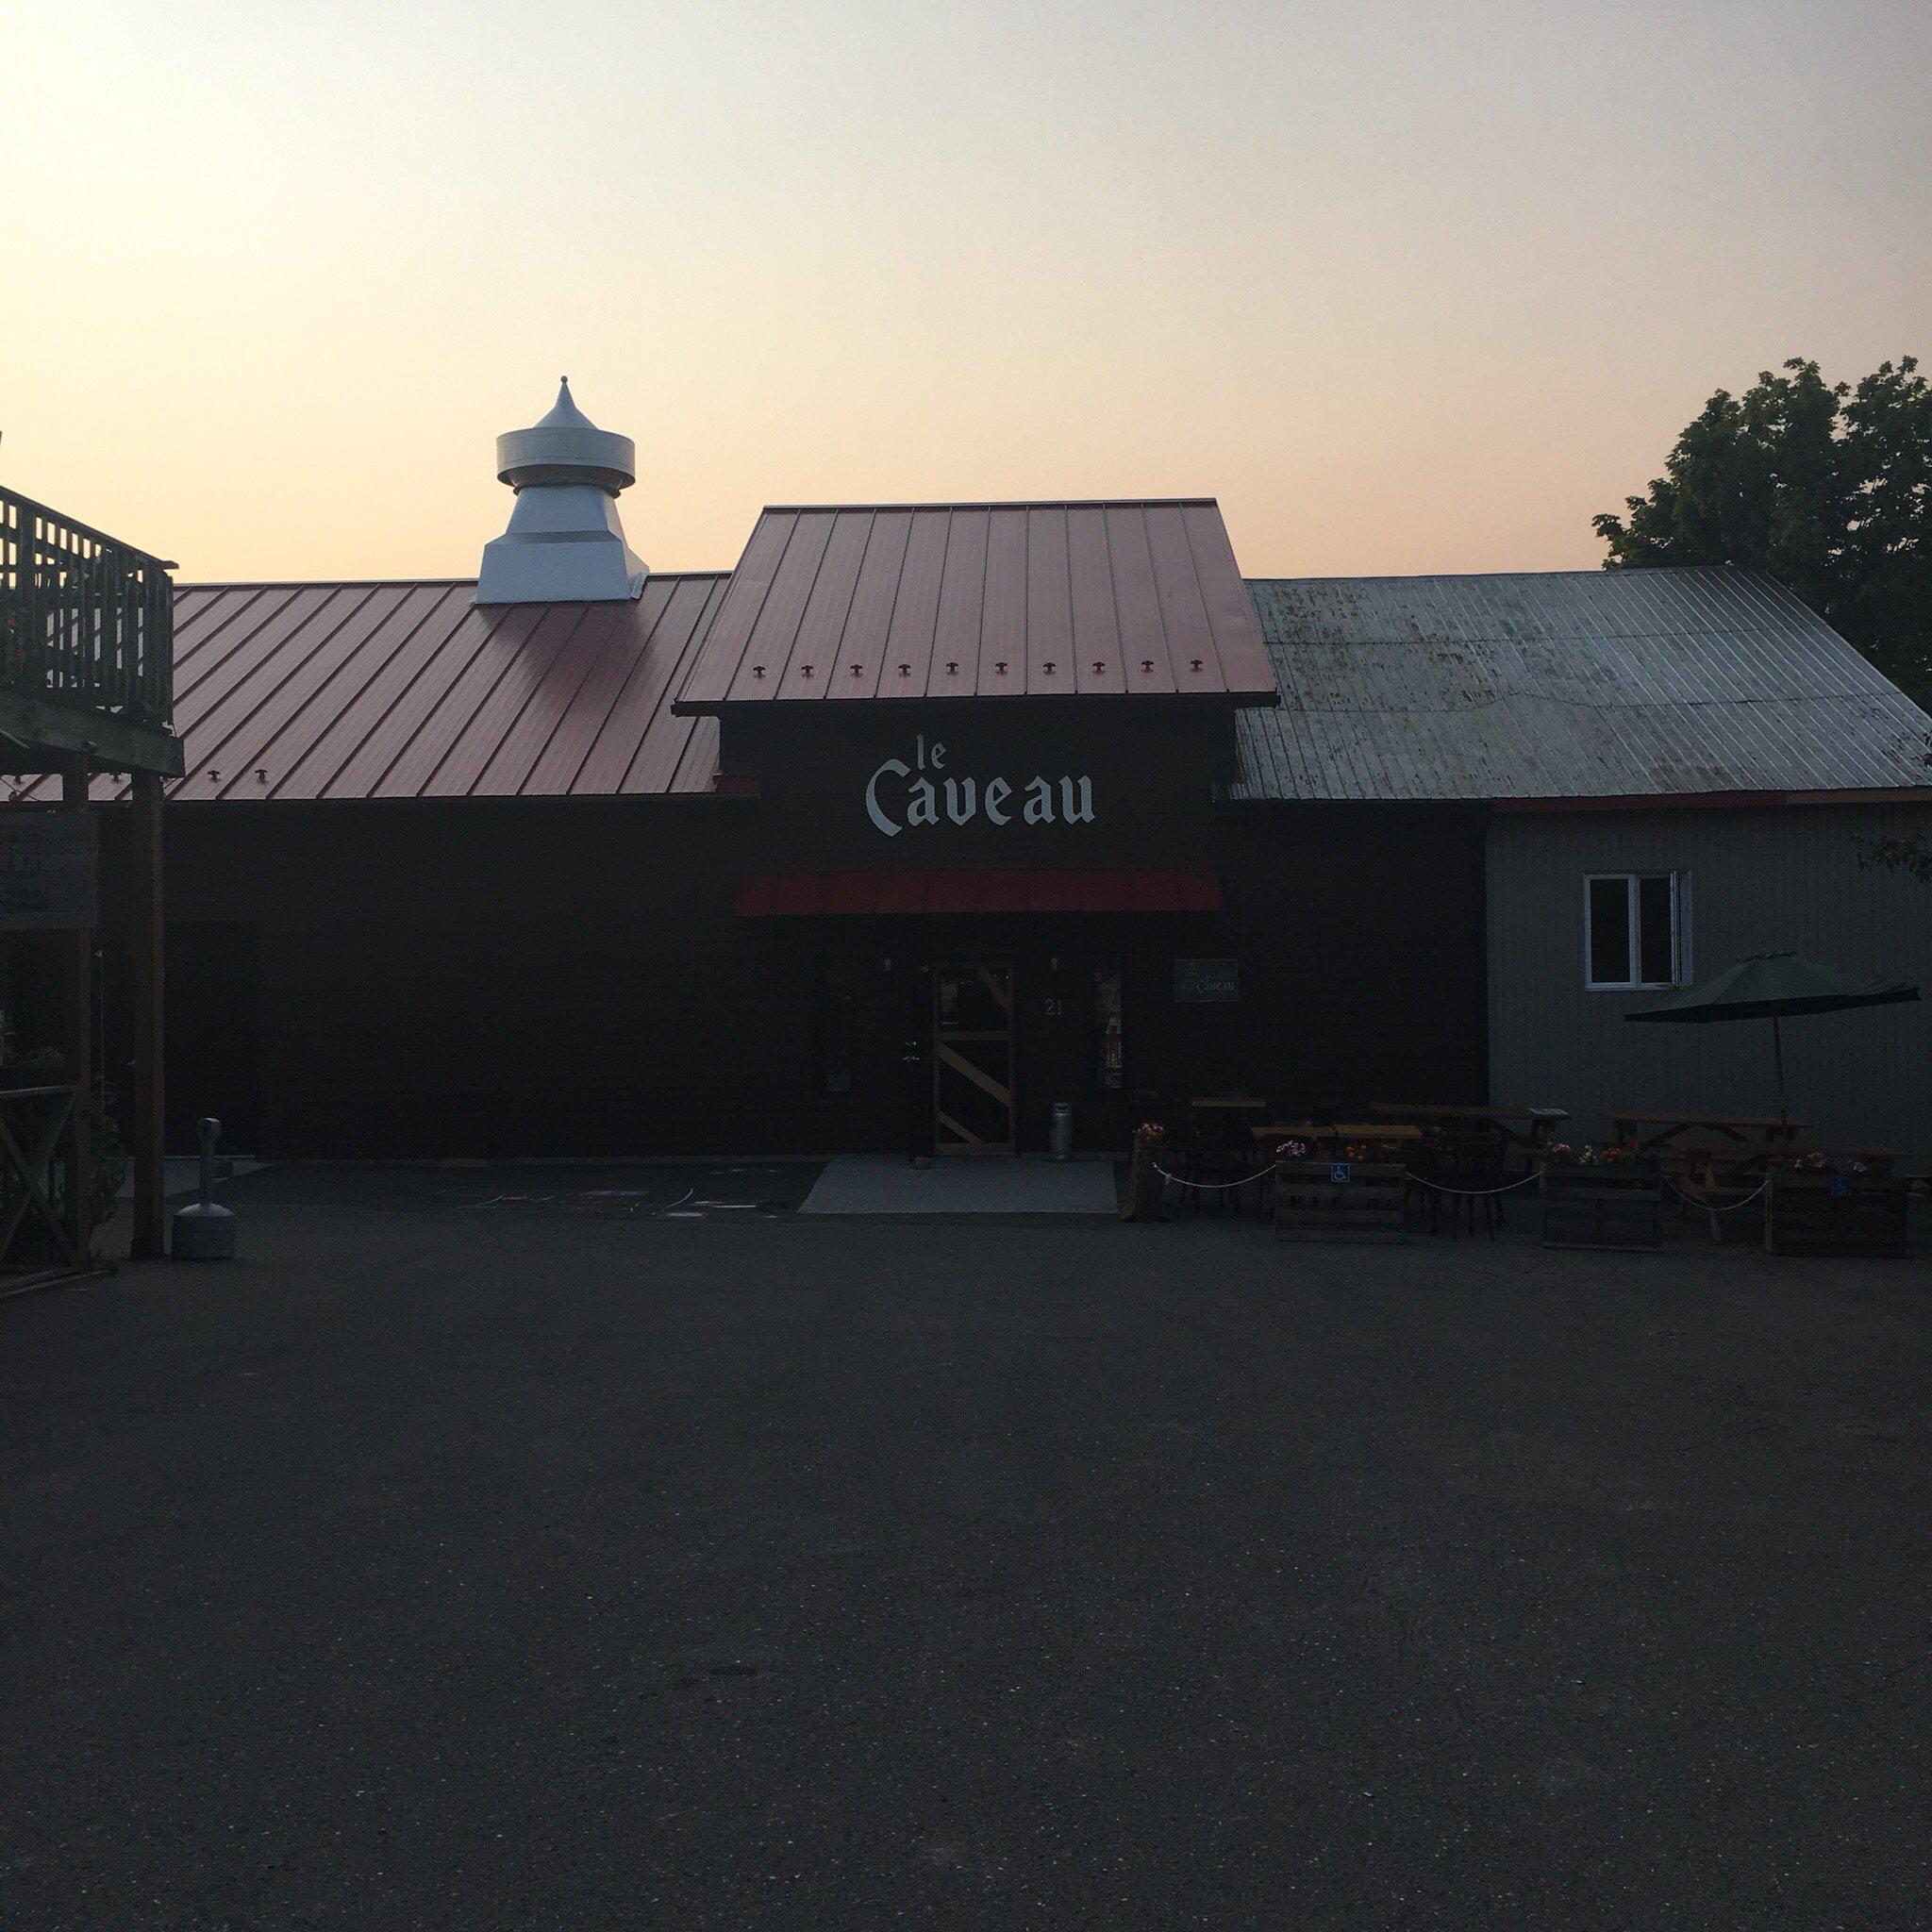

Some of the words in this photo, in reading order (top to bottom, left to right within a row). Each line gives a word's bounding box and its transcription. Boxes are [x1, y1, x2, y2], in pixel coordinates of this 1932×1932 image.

[916, 734, 946, 770] le
[865, 758, 1096, 837] Caveau
[1045, 998, 1063, 1016] 21
